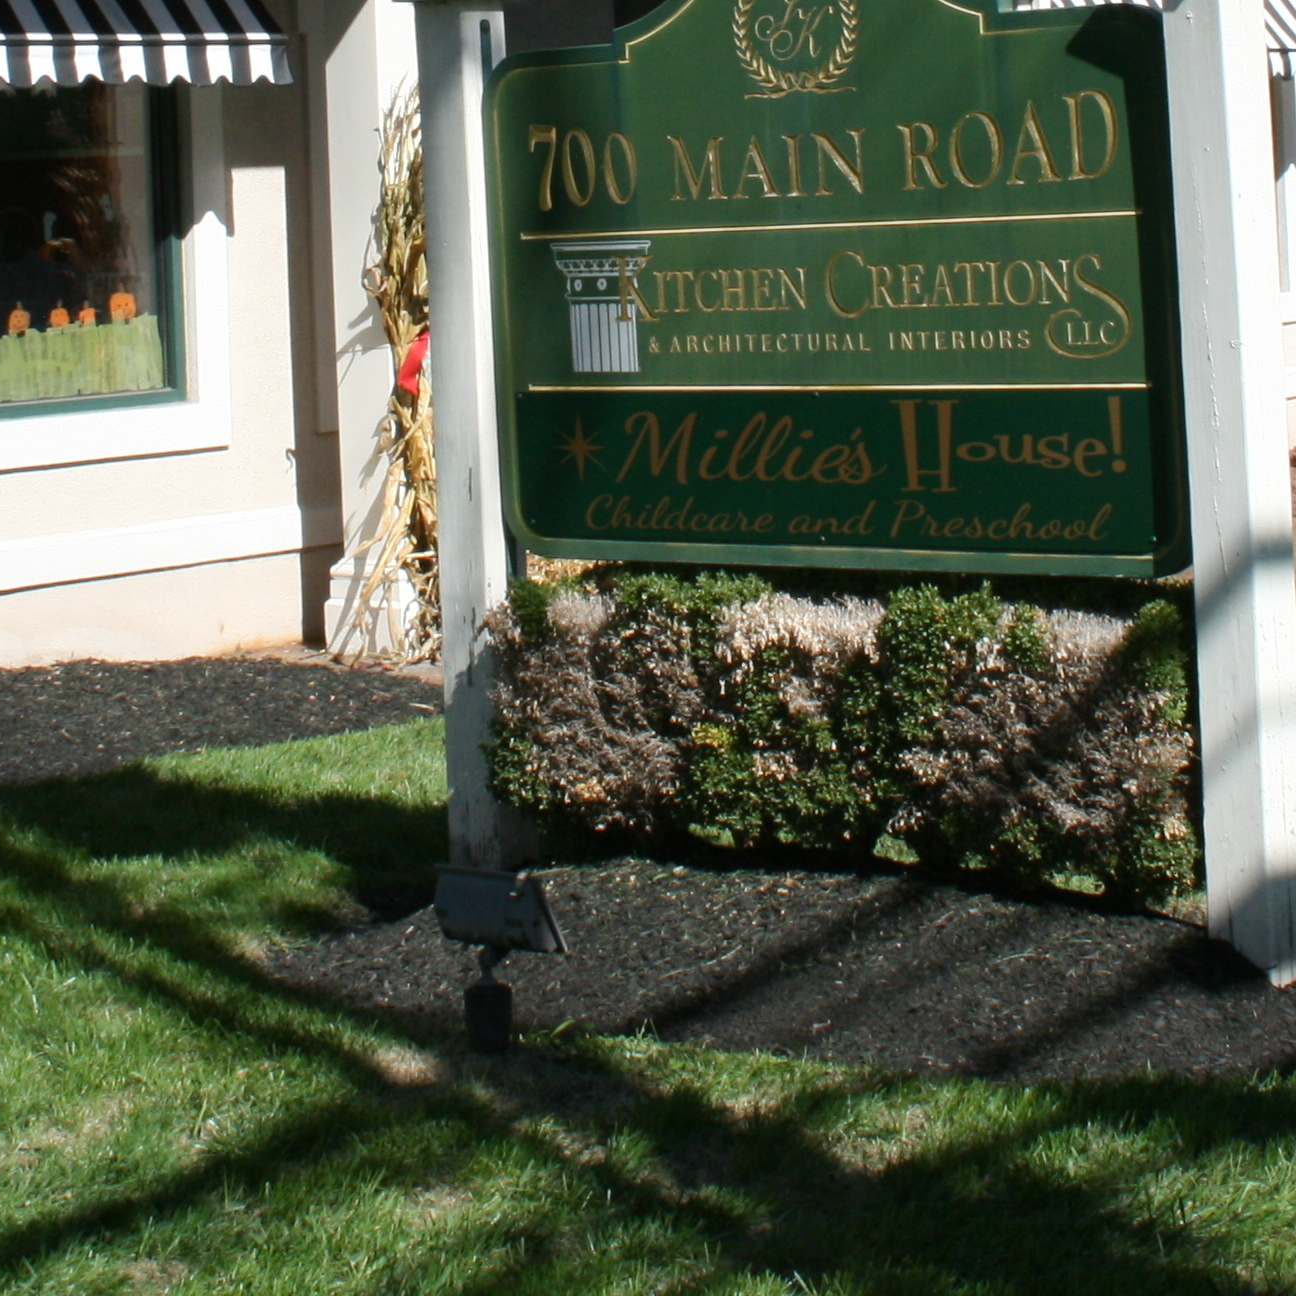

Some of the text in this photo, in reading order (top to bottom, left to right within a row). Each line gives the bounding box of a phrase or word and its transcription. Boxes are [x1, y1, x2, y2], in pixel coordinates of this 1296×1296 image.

[527, 88, 1119, 211] 700 MAIN ROAD
[611, 250, 1133, 359] KITCHEN CREATIONS
[1065, 321, 1117, 346] LLC
[648, 329, 1032, 353] & ARCHITECTURAL INTERIORS
[615, 396, 1127, 492] Millie's House!
[585, 494, 1112, 540] Childcare and Preschool
